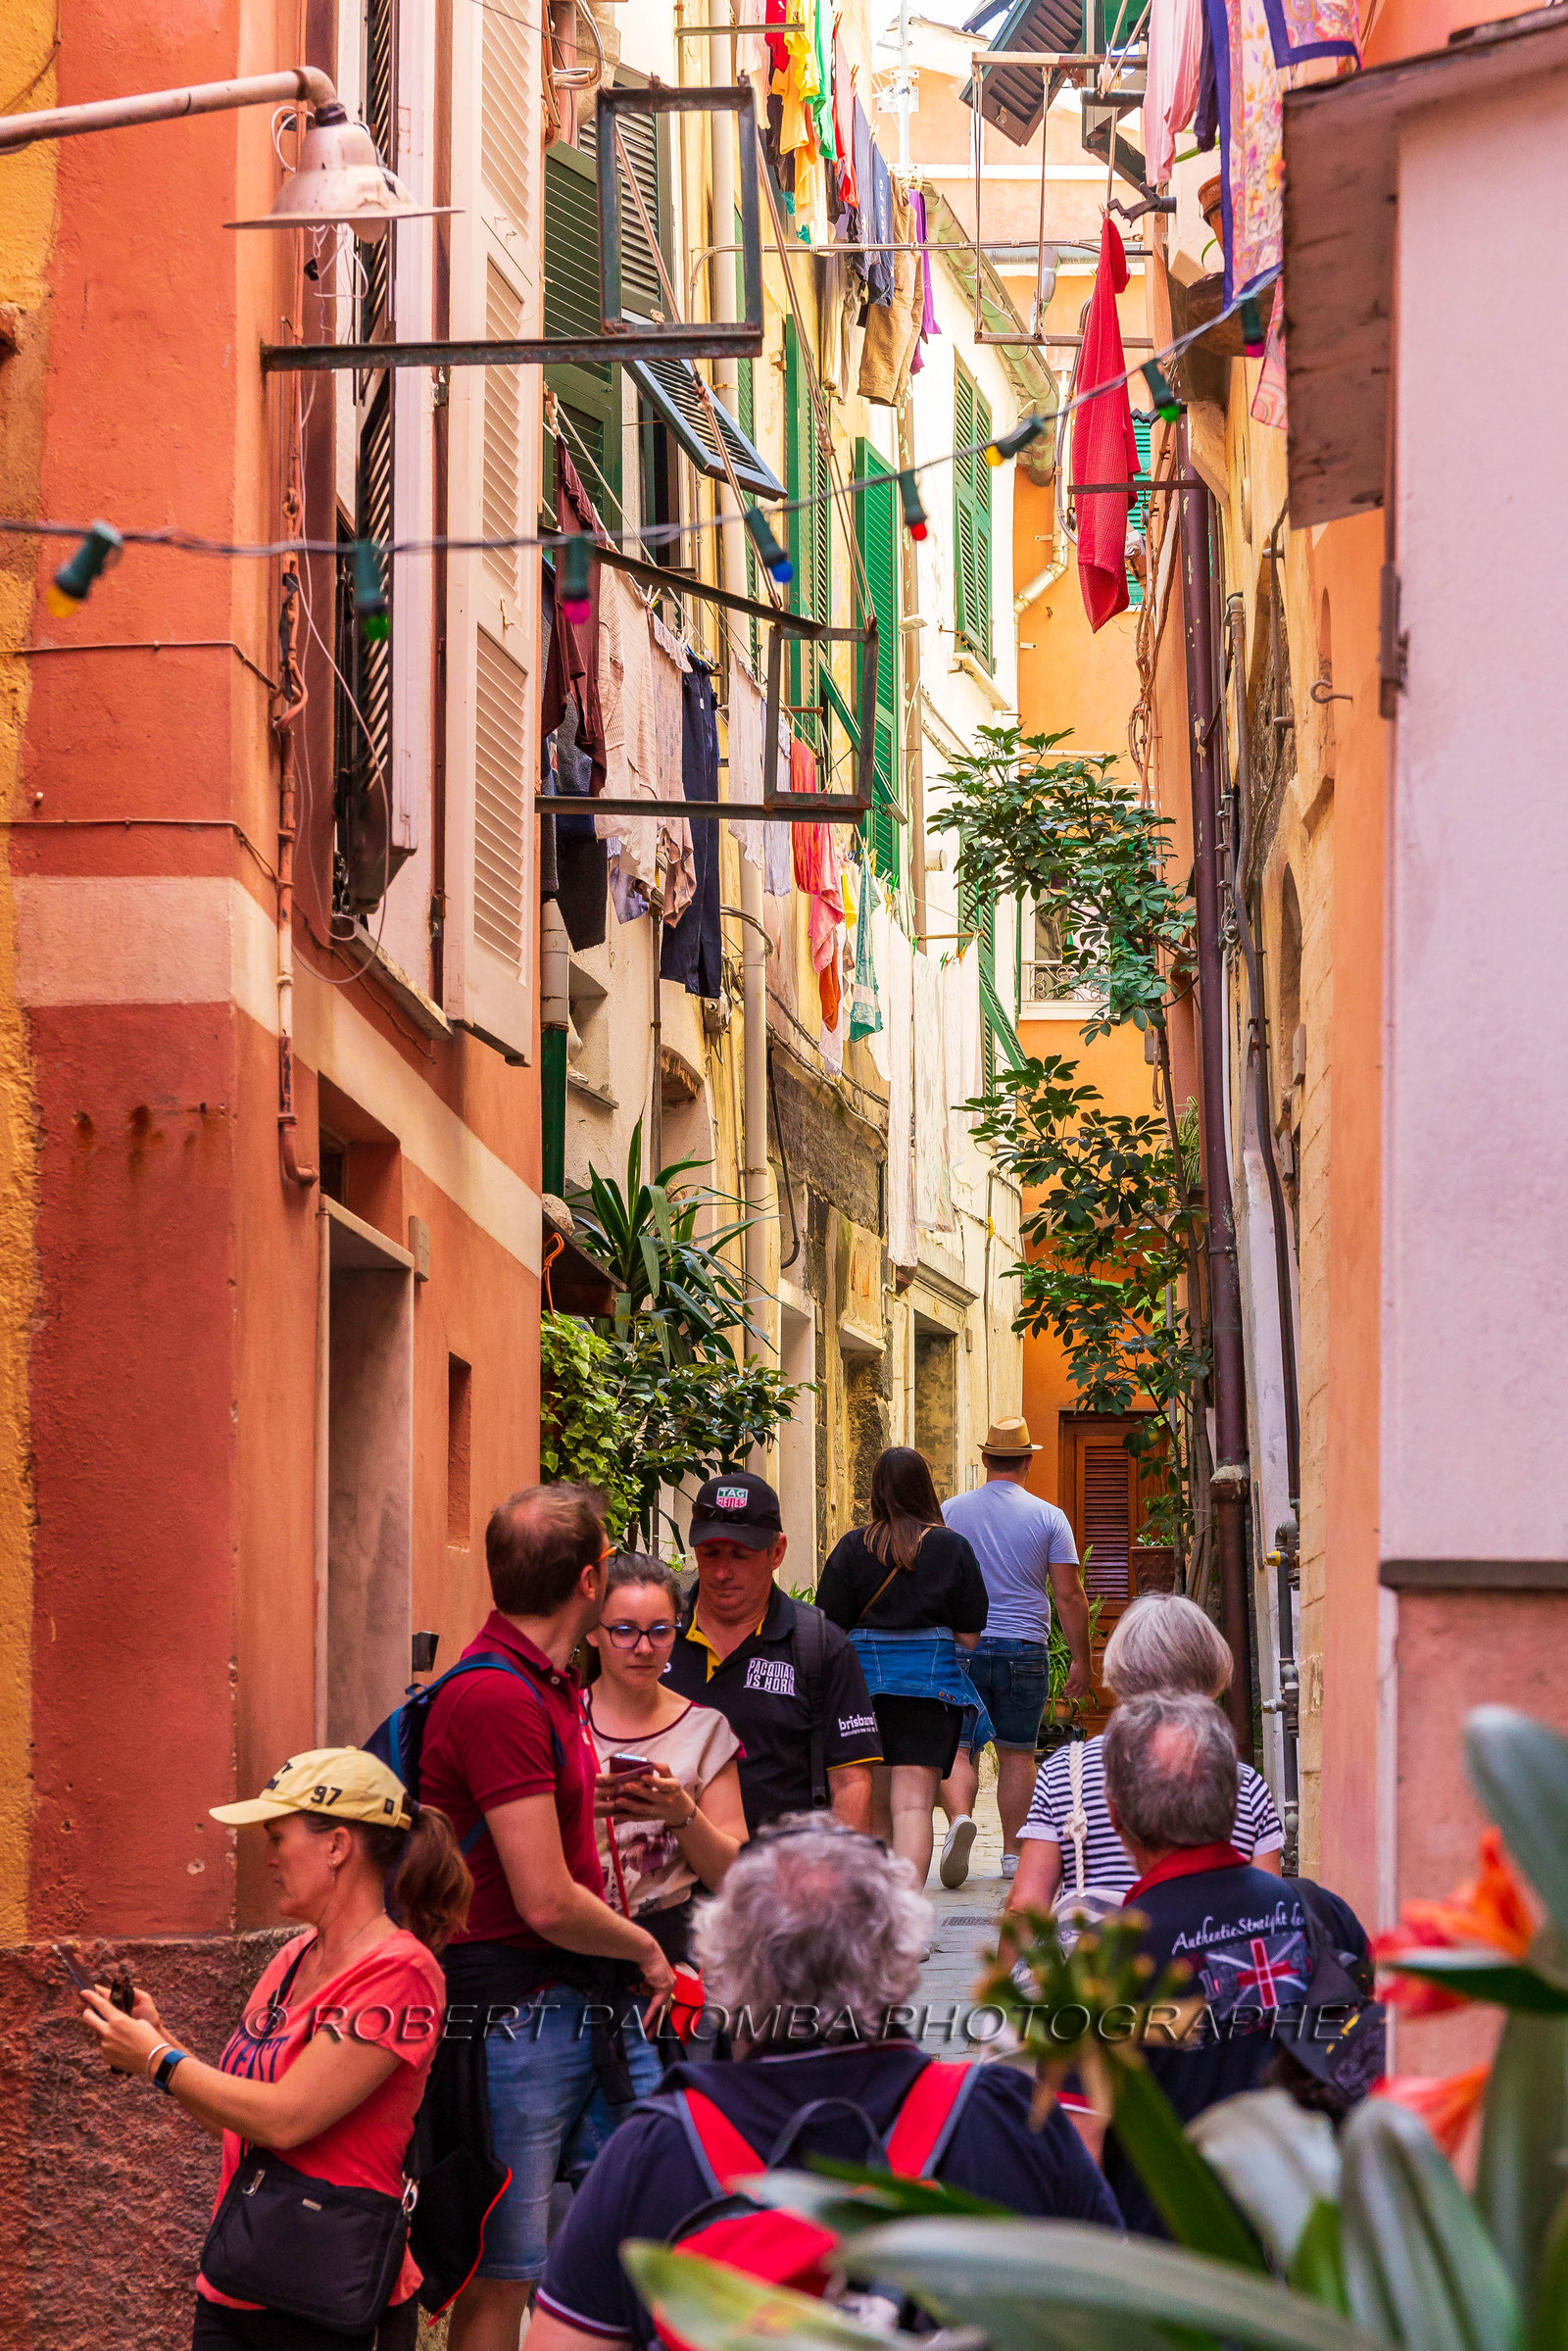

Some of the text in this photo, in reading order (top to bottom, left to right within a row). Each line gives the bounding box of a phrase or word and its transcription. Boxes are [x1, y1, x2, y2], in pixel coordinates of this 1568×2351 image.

[720, 1489, 745, 1498] TAG
[748, 1660, 795, 1681] PACQUIAO
[747, 1674, 795, 1694] VS HORN
[311, 1786, 343, 1806] 97
